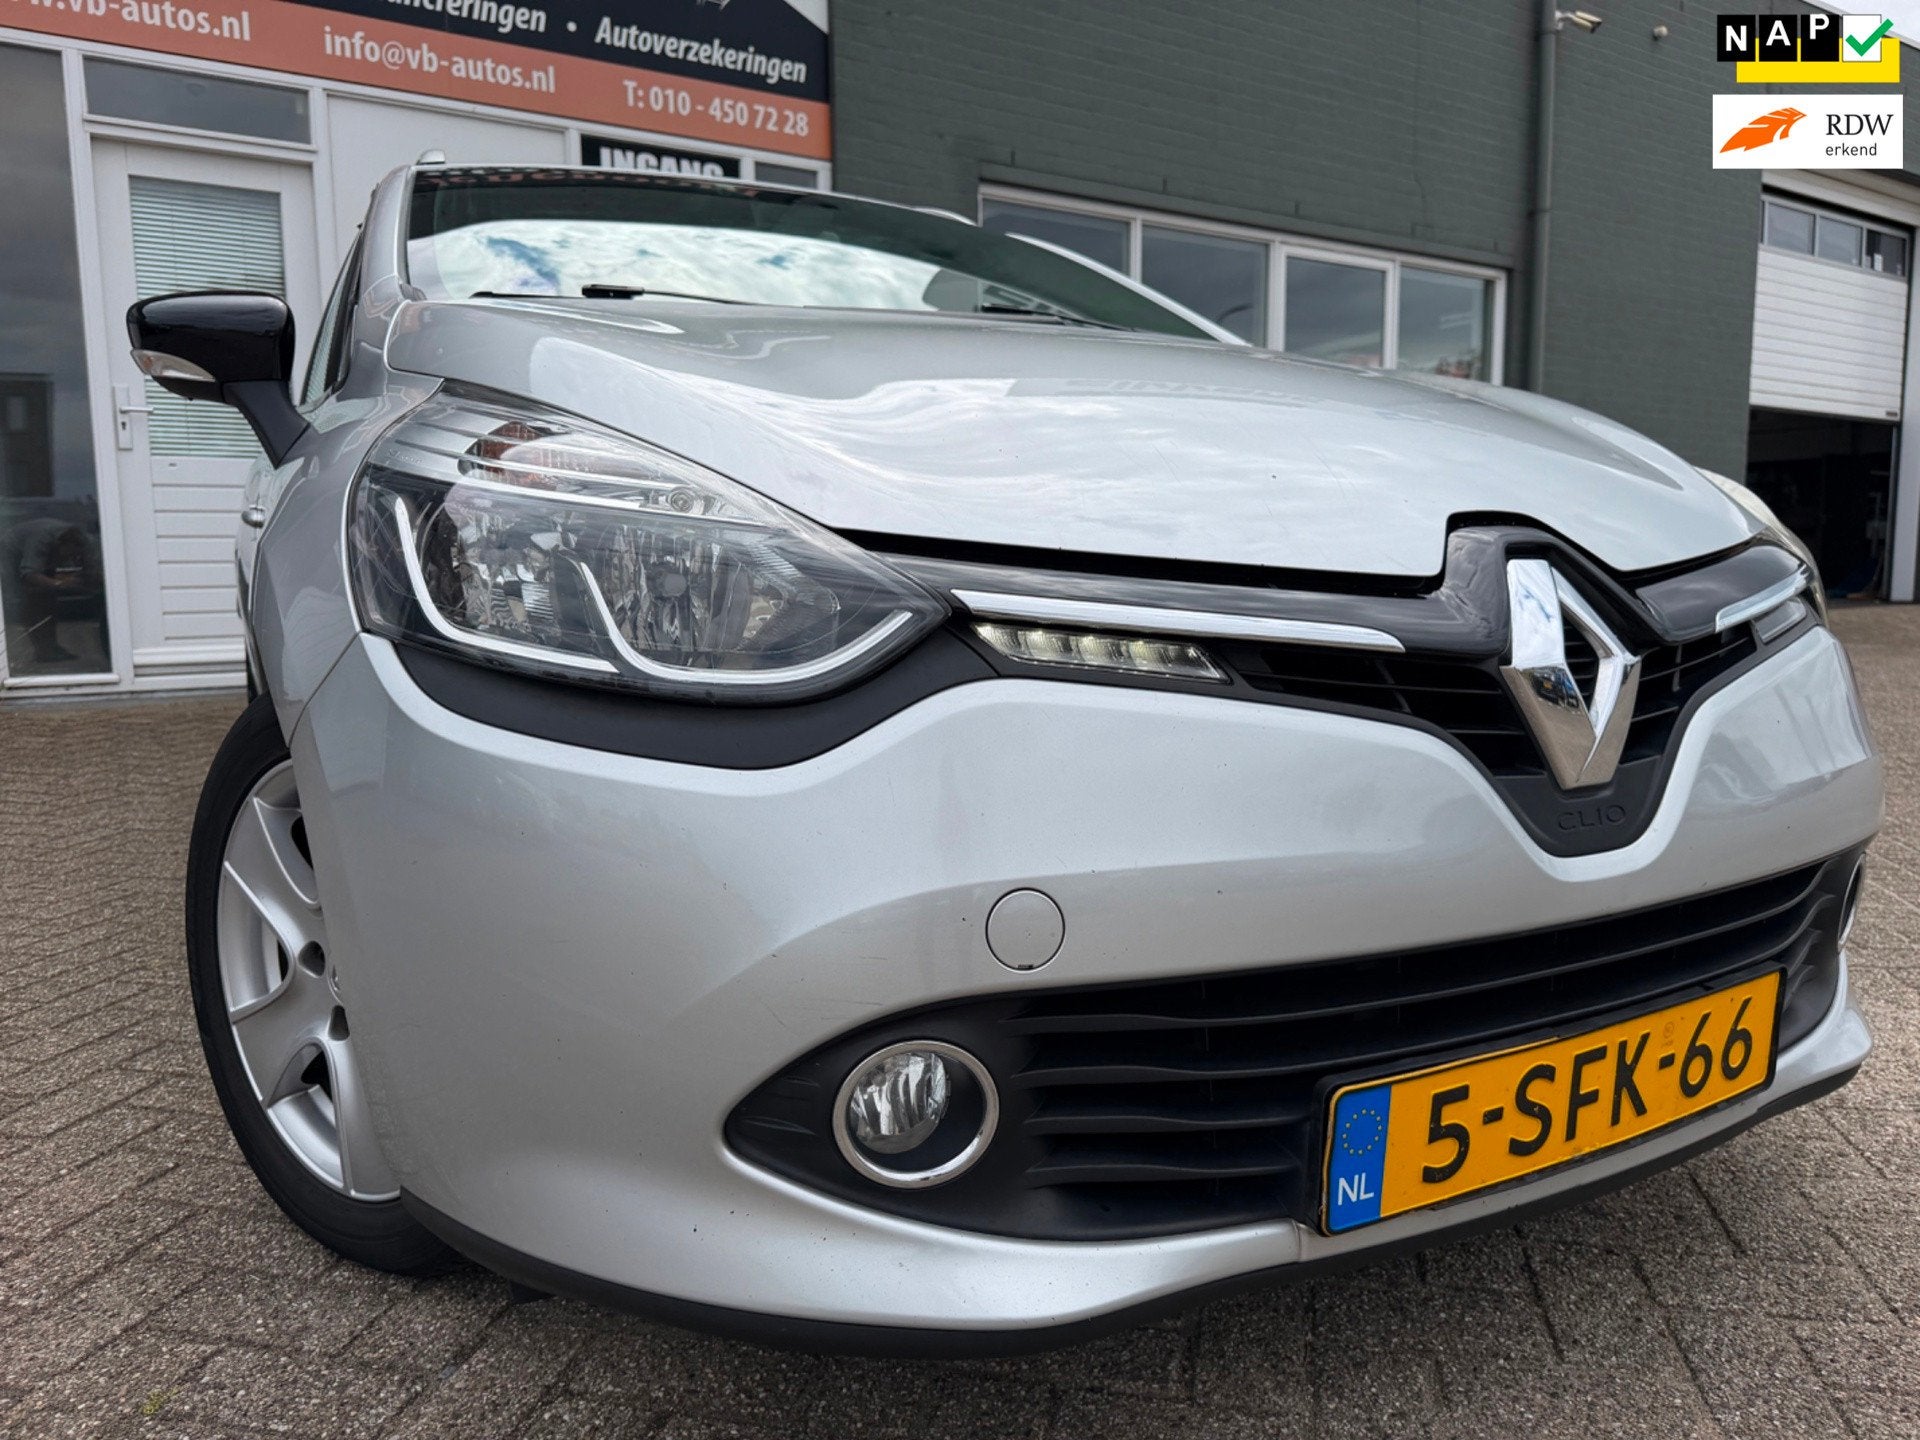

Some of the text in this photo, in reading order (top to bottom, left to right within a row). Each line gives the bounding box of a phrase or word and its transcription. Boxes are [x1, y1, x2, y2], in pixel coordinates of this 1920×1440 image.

[12, 0, 251, 41] .vb-autos.nl
[325, 26, 556, 94] info@vb-autos.nl
[595, 16, 808, 85] Autoverzekeringen
[623, 79, 645, 108] T:
[649, 86, 691, 116] 010
[708, 97, 750, 127] 450
[752, 105, 780, 132] 72
[783, 111, 809, 137] 28
[1558, 804, 1627, 831] CLIO
[1421, 997, 1753, 1184] 5-SFK-66
[1337, 1172, 1375, 1206] NL
